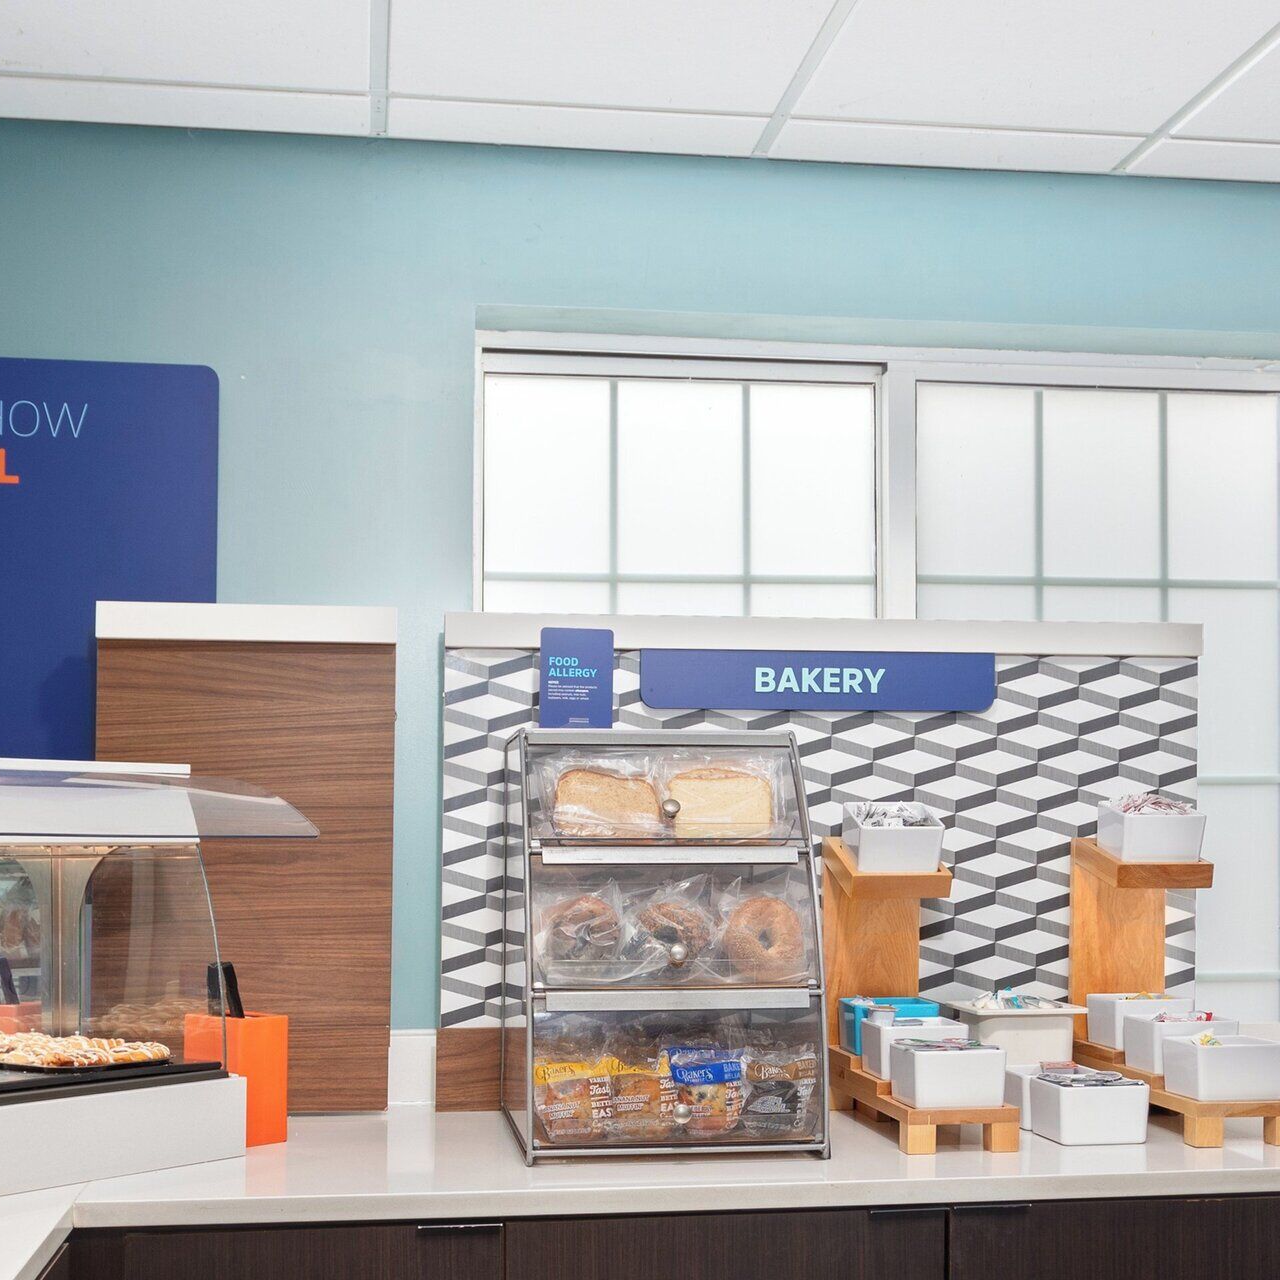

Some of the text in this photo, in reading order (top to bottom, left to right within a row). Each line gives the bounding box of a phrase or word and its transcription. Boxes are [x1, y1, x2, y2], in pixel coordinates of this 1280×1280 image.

[548, 656, 579, 666] FOOD
[548, 667, 598, 678] ALLERGY
[753, 667, 886, 694] BAKERY
[723, 1062, 741, 1072] BAKE
